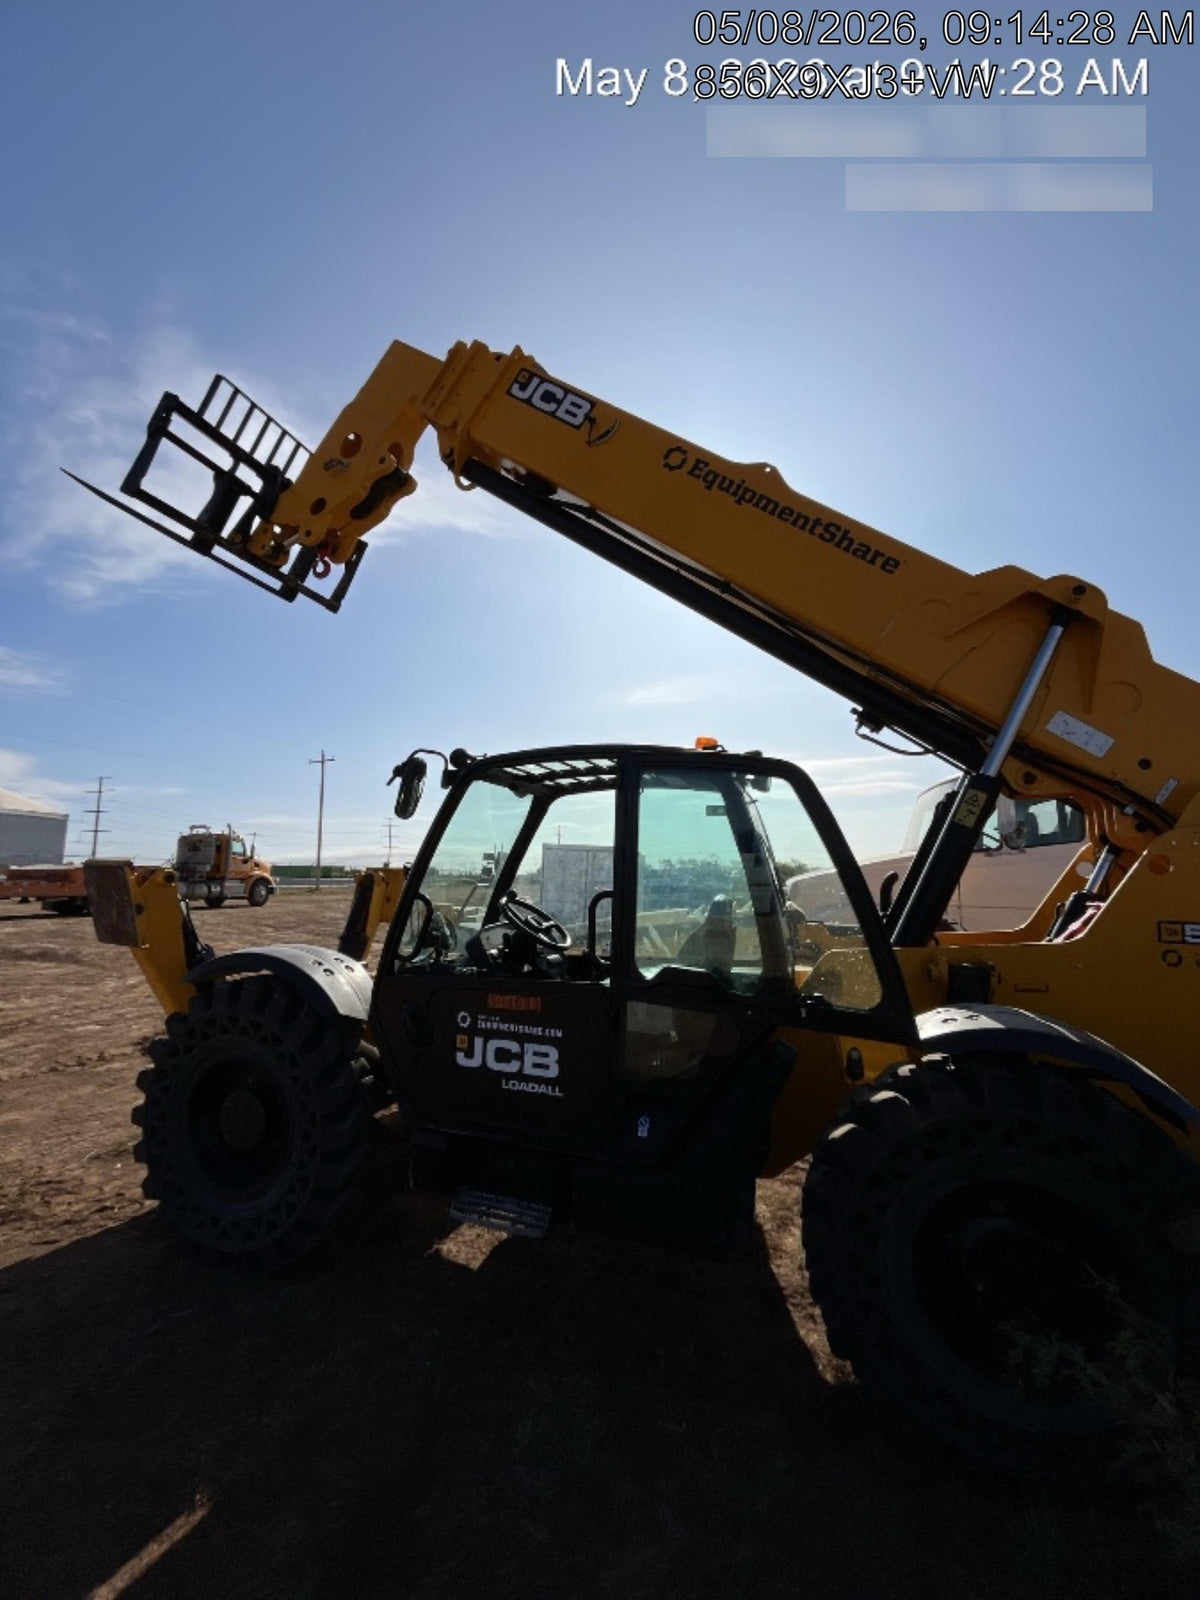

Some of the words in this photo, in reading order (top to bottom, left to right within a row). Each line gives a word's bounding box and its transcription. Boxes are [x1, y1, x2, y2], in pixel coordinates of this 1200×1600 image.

[509, 375, 592, 427] JCB
[686, 457, 900, 575] EquipmentShare
[456, 1036, 560, 1079] JCB
[501, 1079, 563, 1097] LOADALL
